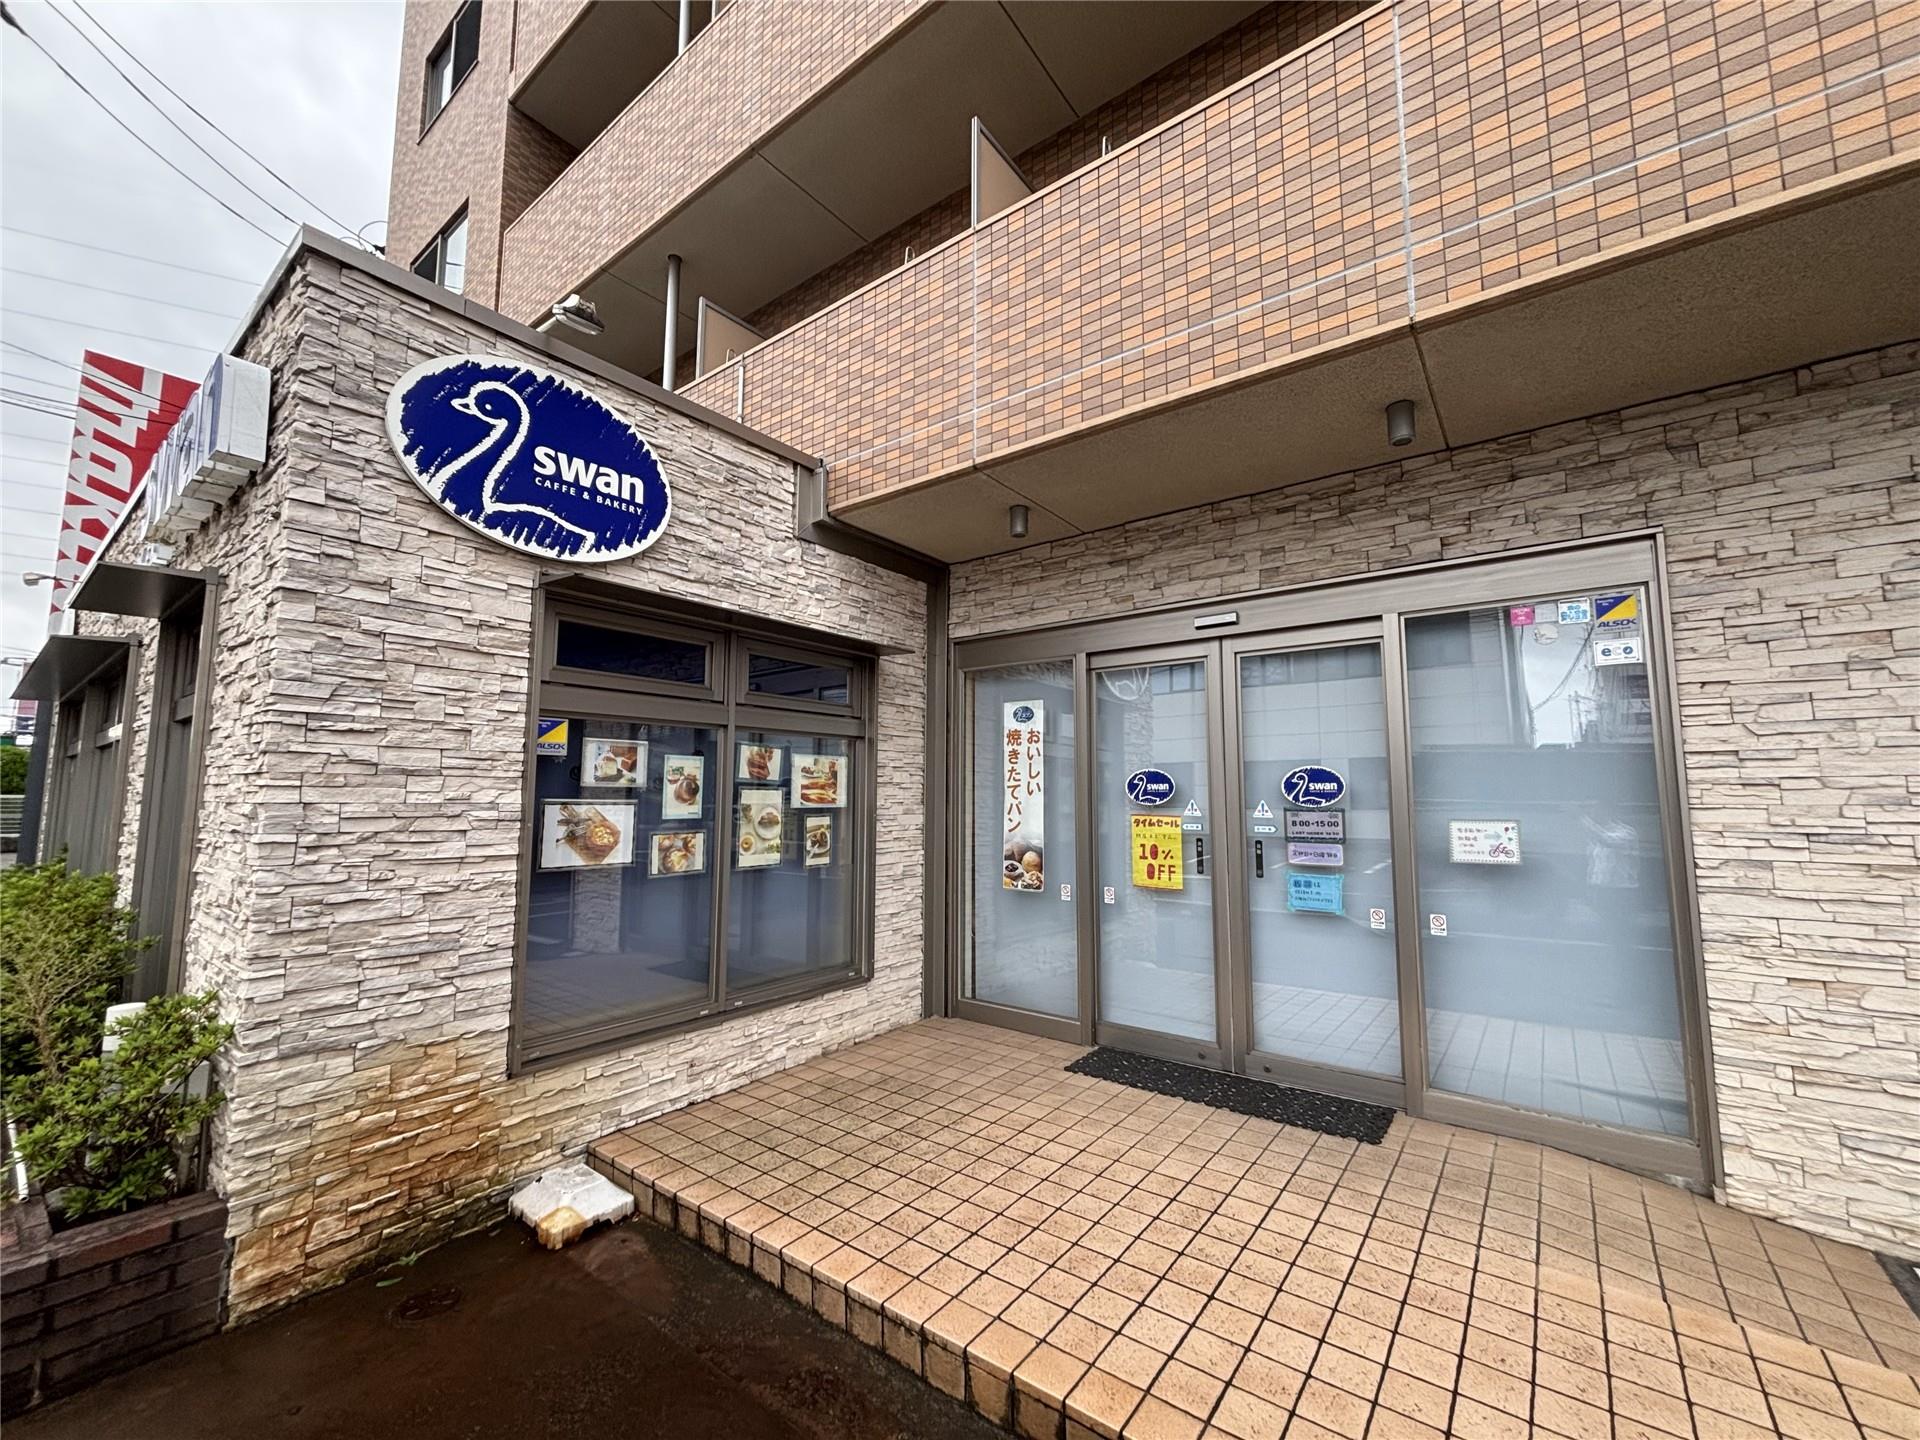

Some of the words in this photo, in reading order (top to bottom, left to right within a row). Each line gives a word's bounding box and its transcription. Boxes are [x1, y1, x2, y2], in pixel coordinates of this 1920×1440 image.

[533, 445, 645, 504] swan
[535, 477, 576, 496] CAFFE
[582, 490, 590, 500] &
[596, 495, 643, 515] BAKERY
[1597, 618, 1637, 628] ALSOK
[1026, 727, 1042, 796] おいしい
[1006, 729, 1022, 833] 焼きたてパン
[1309, 782, 1337, 790] swan
[1133, 818, 1180, 828] タイムセール
[1139, 843, 1174, 860] 10%
[1146, 864, 1177, 881] OFF
